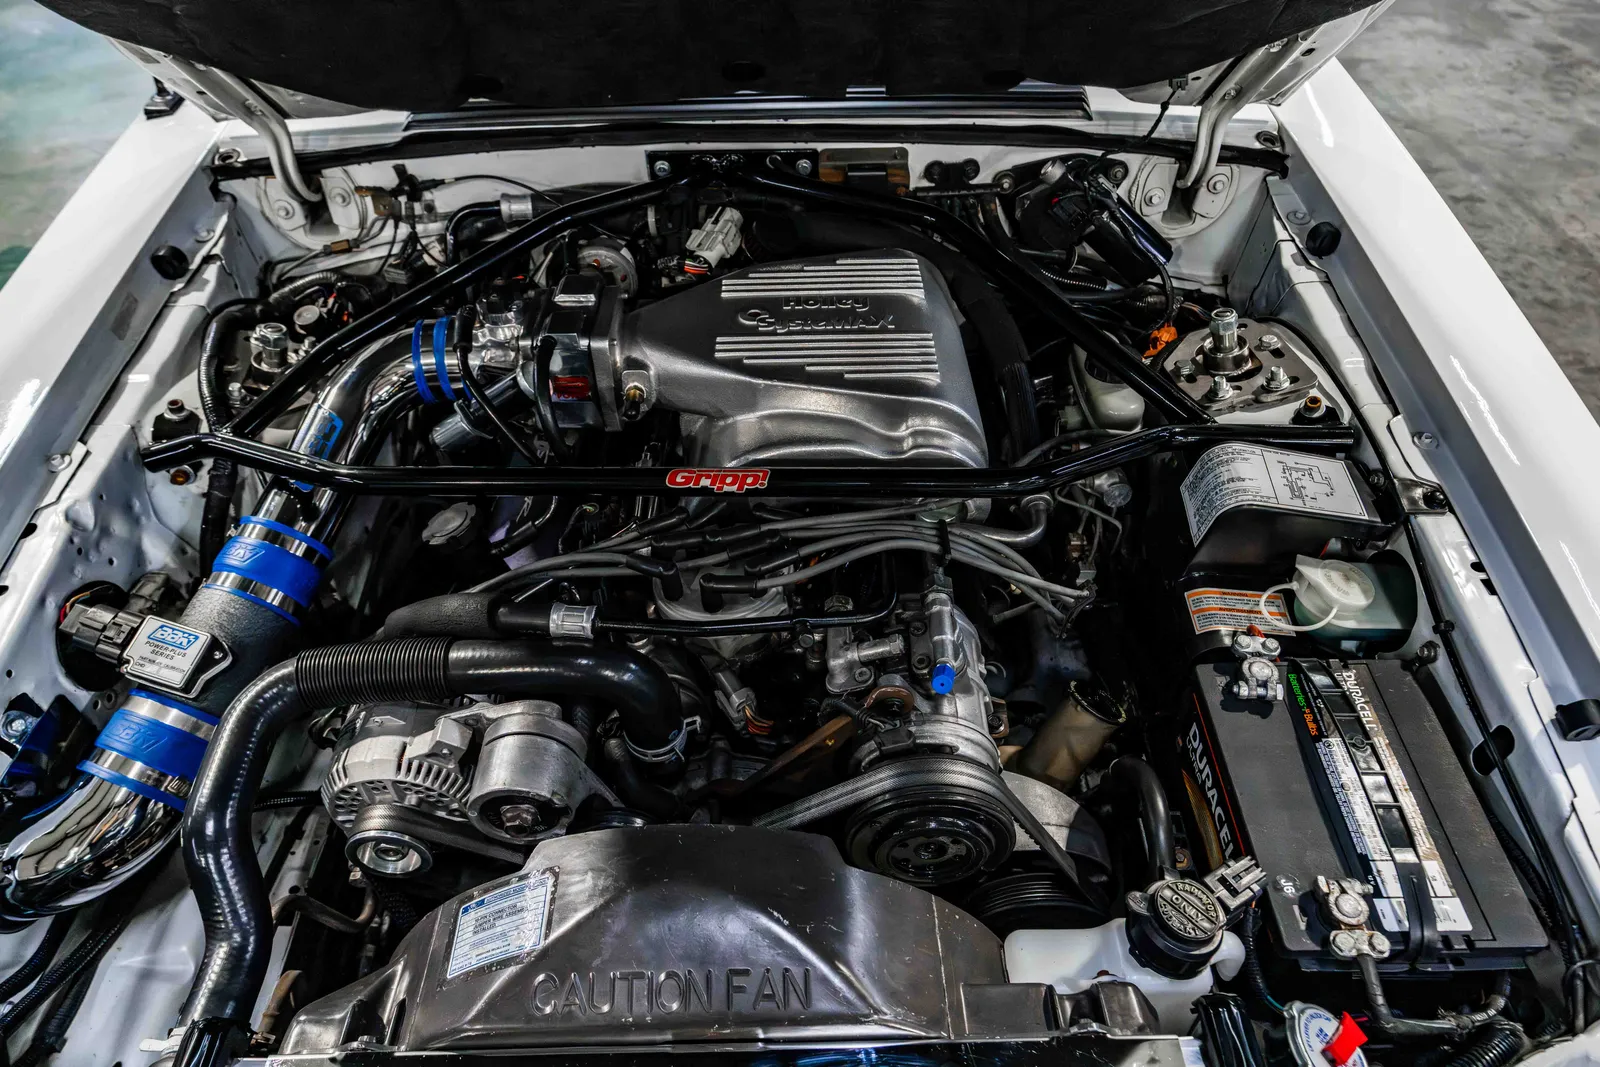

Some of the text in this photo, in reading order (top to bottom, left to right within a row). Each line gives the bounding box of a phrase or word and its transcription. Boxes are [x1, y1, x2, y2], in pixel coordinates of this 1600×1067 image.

[782, 296, 870, 312] Holley
[666, 468, 770, 493] Gripp!
[144, 640, 187, 658] POWER-PLUS
[151, 625, 195, 648] BBK
[150, 648, 176, 661] SERIES
[1288, 673, 1306, 710] Batteries
[1303, 713, 1318, 736] Bulbs
[1342, 669, 1377, 731] DURACELL
[1189, 722, 1234, 860] DURACEL
[1172, 895, 1205, 922] ONLY
[1177, 882, 1217, 918] RADIATOR
[530, 966, 813, 1018] CAUTION FAN
